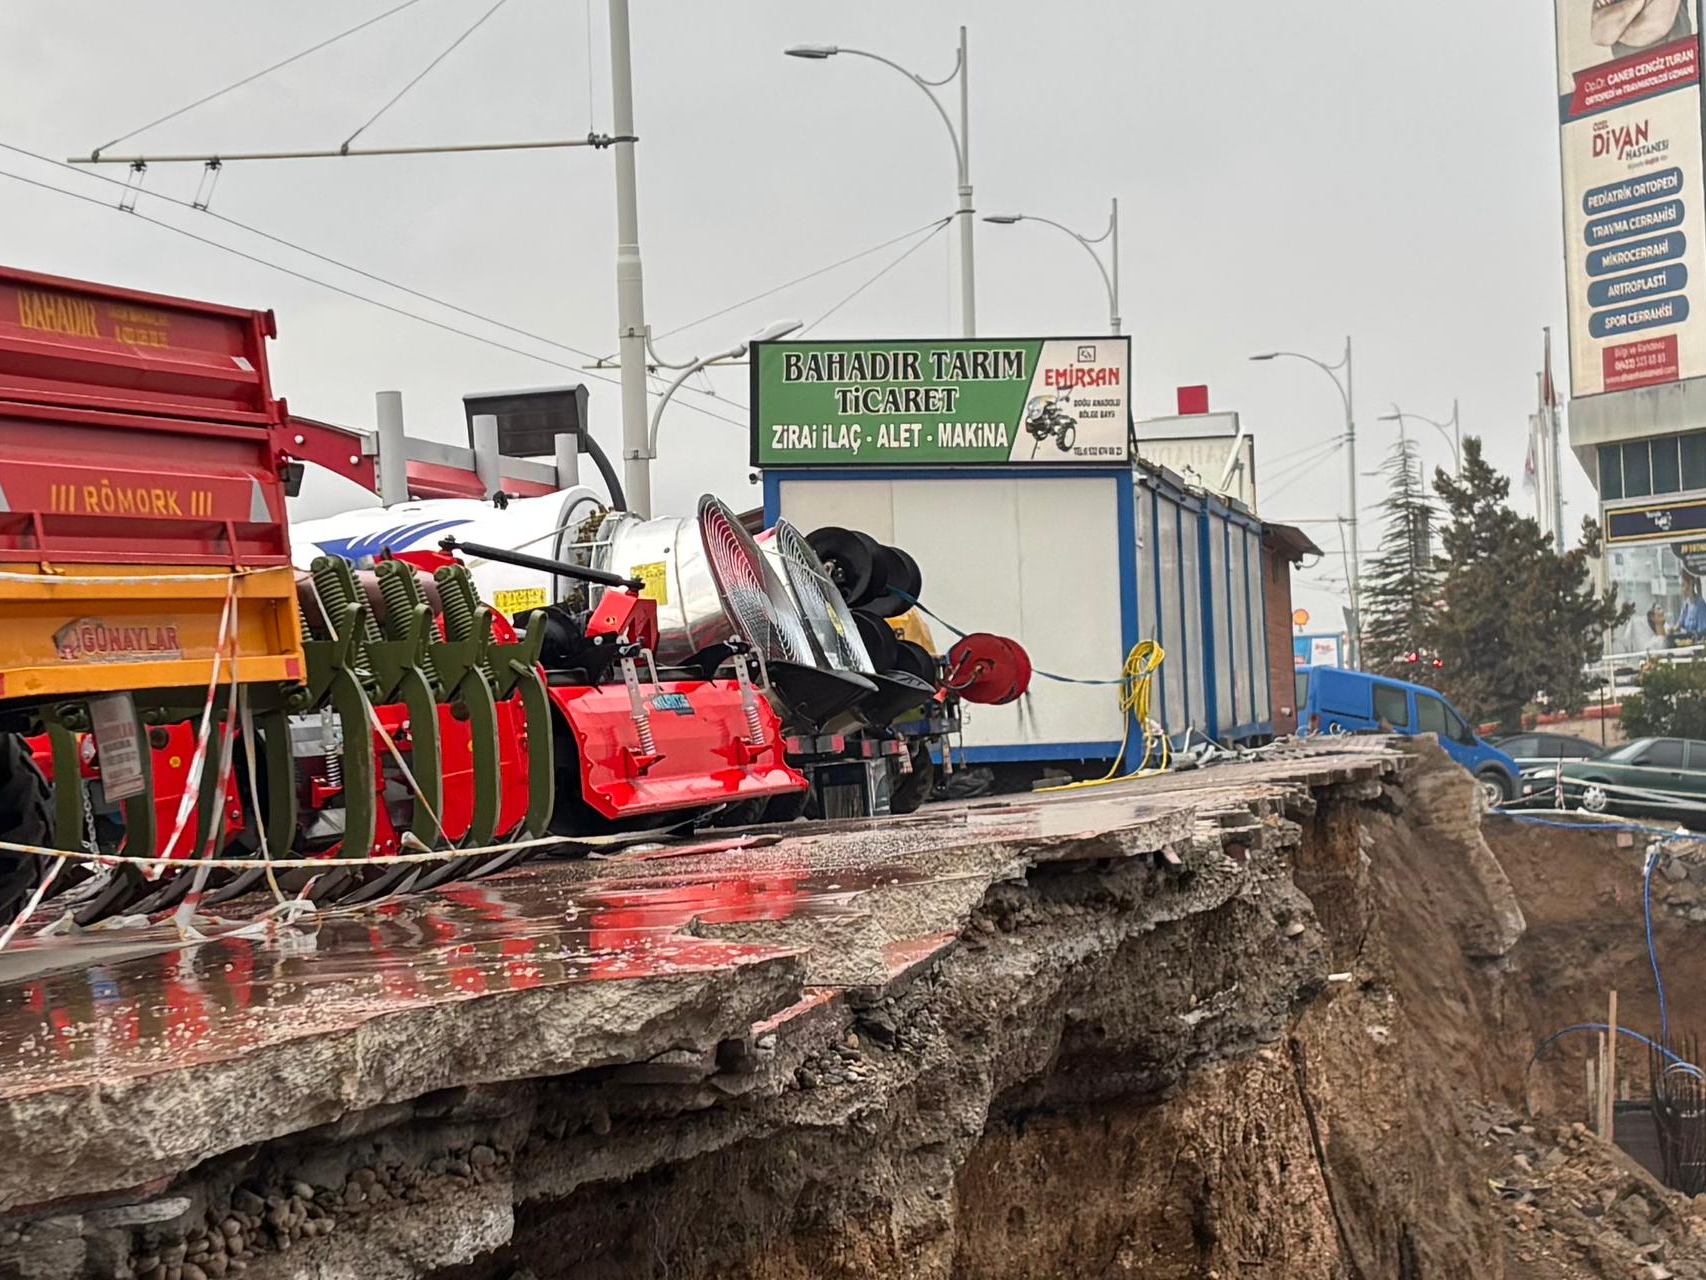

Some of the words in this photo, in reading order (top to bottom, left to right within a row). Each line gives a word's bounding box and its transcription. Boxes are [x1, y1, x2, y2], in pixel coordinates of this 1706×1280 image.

[1664, 48, 1694, 68] TURAN
[1588, 183, 1632, 209] PEDİATRİK
[1632, 170, 1678, 197] ORTOPEDİ
[1592, 219, 1629, 239] TRAVMA
[1629, 203, 1676, 230] CERRAHİSİ
[1601, 239, 1670, 268] MİKROCERRAHİ
[17, 288, 102, 339] BAHADIR
[1604, 314, 1628, 330] SPOR
[783, 350, 924, 383] BAHADIR
[929, 349, 1027, 382] TARIM
[876, 423, 923, 449] ALET
[82, 478, 183, 517] RÖMORK
[80, 619, 181, 653] GÜNAYLAR
